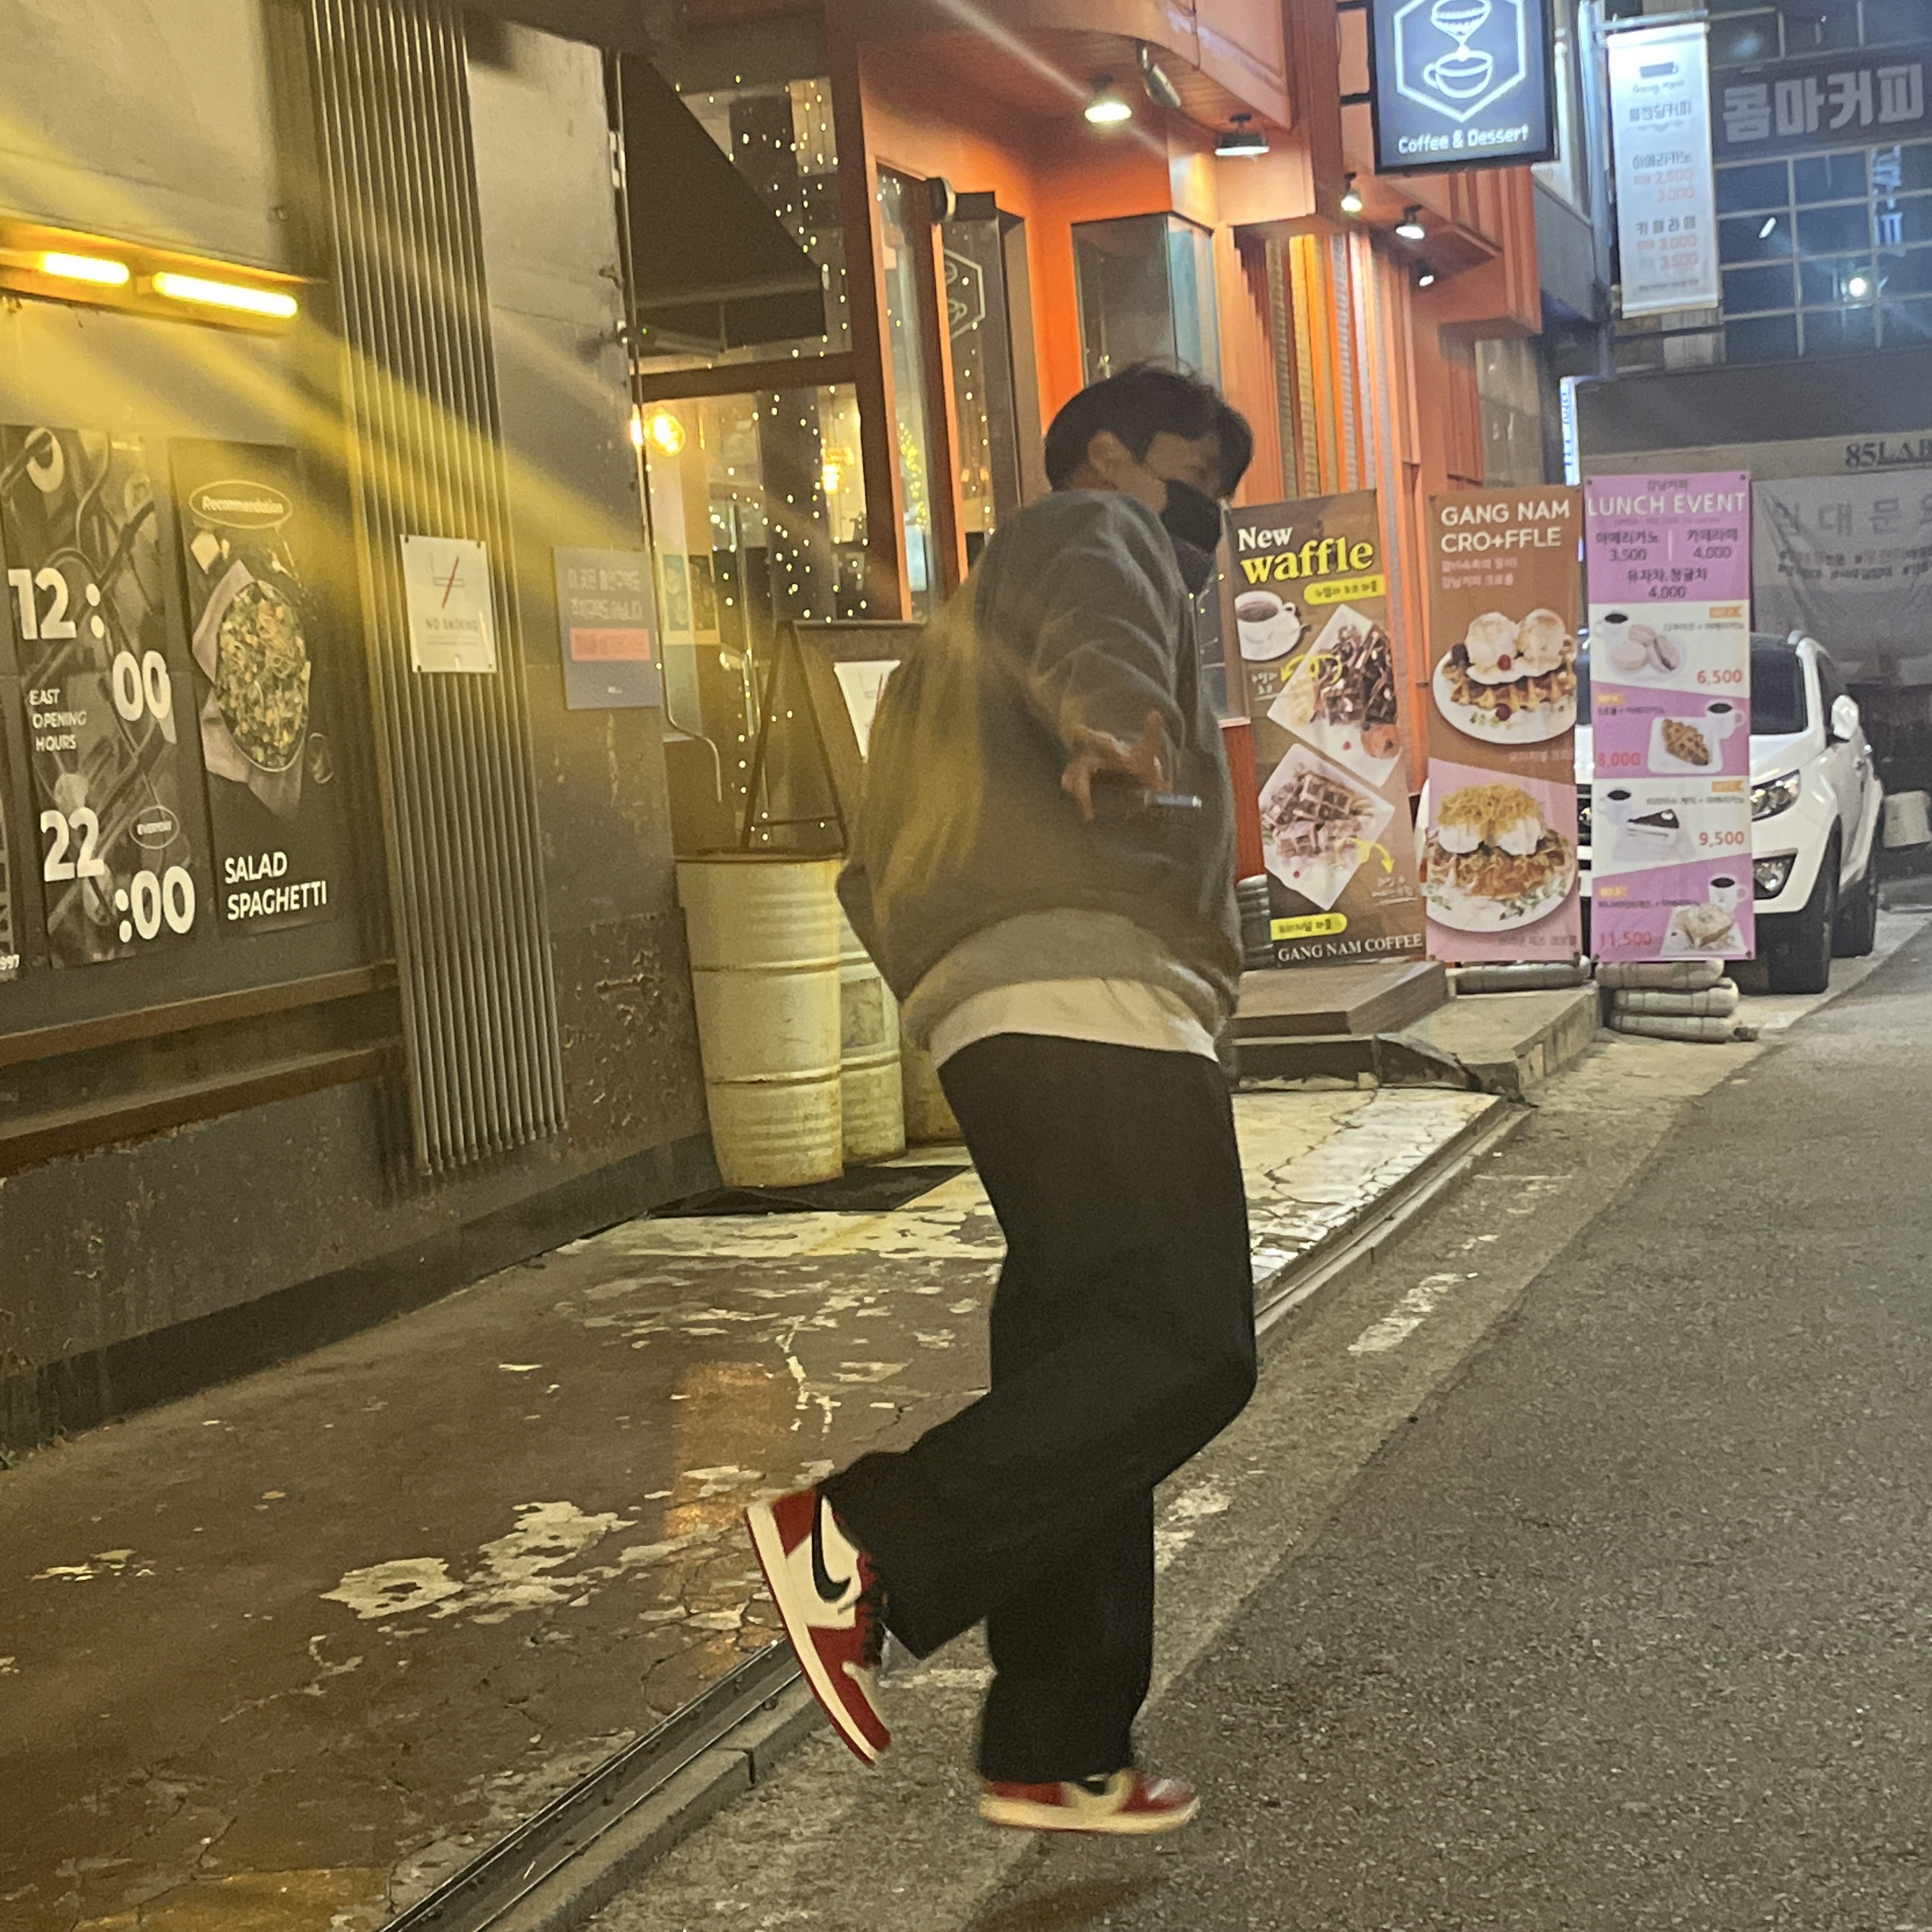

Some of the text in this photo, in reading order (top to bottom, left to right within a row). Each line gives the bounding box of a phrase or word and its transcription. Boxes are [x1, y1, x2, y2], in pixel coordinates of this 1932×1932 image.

[1398, 124, 1529, 155] Coffee & Dessert
[1441, 500, 1570, 526] GANG NAM
[1588, 492, 1747, 517] LUNCH EVENT
[1238, 526, 1293, 551] New
[1441, 526, 1561, 554] CRO+FFLE
[1241, 536, 1374, 585] waffle
[1697, 669, 1743, 686] 6,500
[29, 688, 61, 706] EAST
[33, 710, 87, 729] OPENING
[36, 734, 77, 752] HOURS
[40, 807, 105, 882] 22
[1699, 831, 1745, 848] 9,500
[225, 851, 288, 884] SALAD
[227, 880, 327, 921] SPAGHETTI
[1278, 933, 1423, 962] GANG NAM COFFEE
